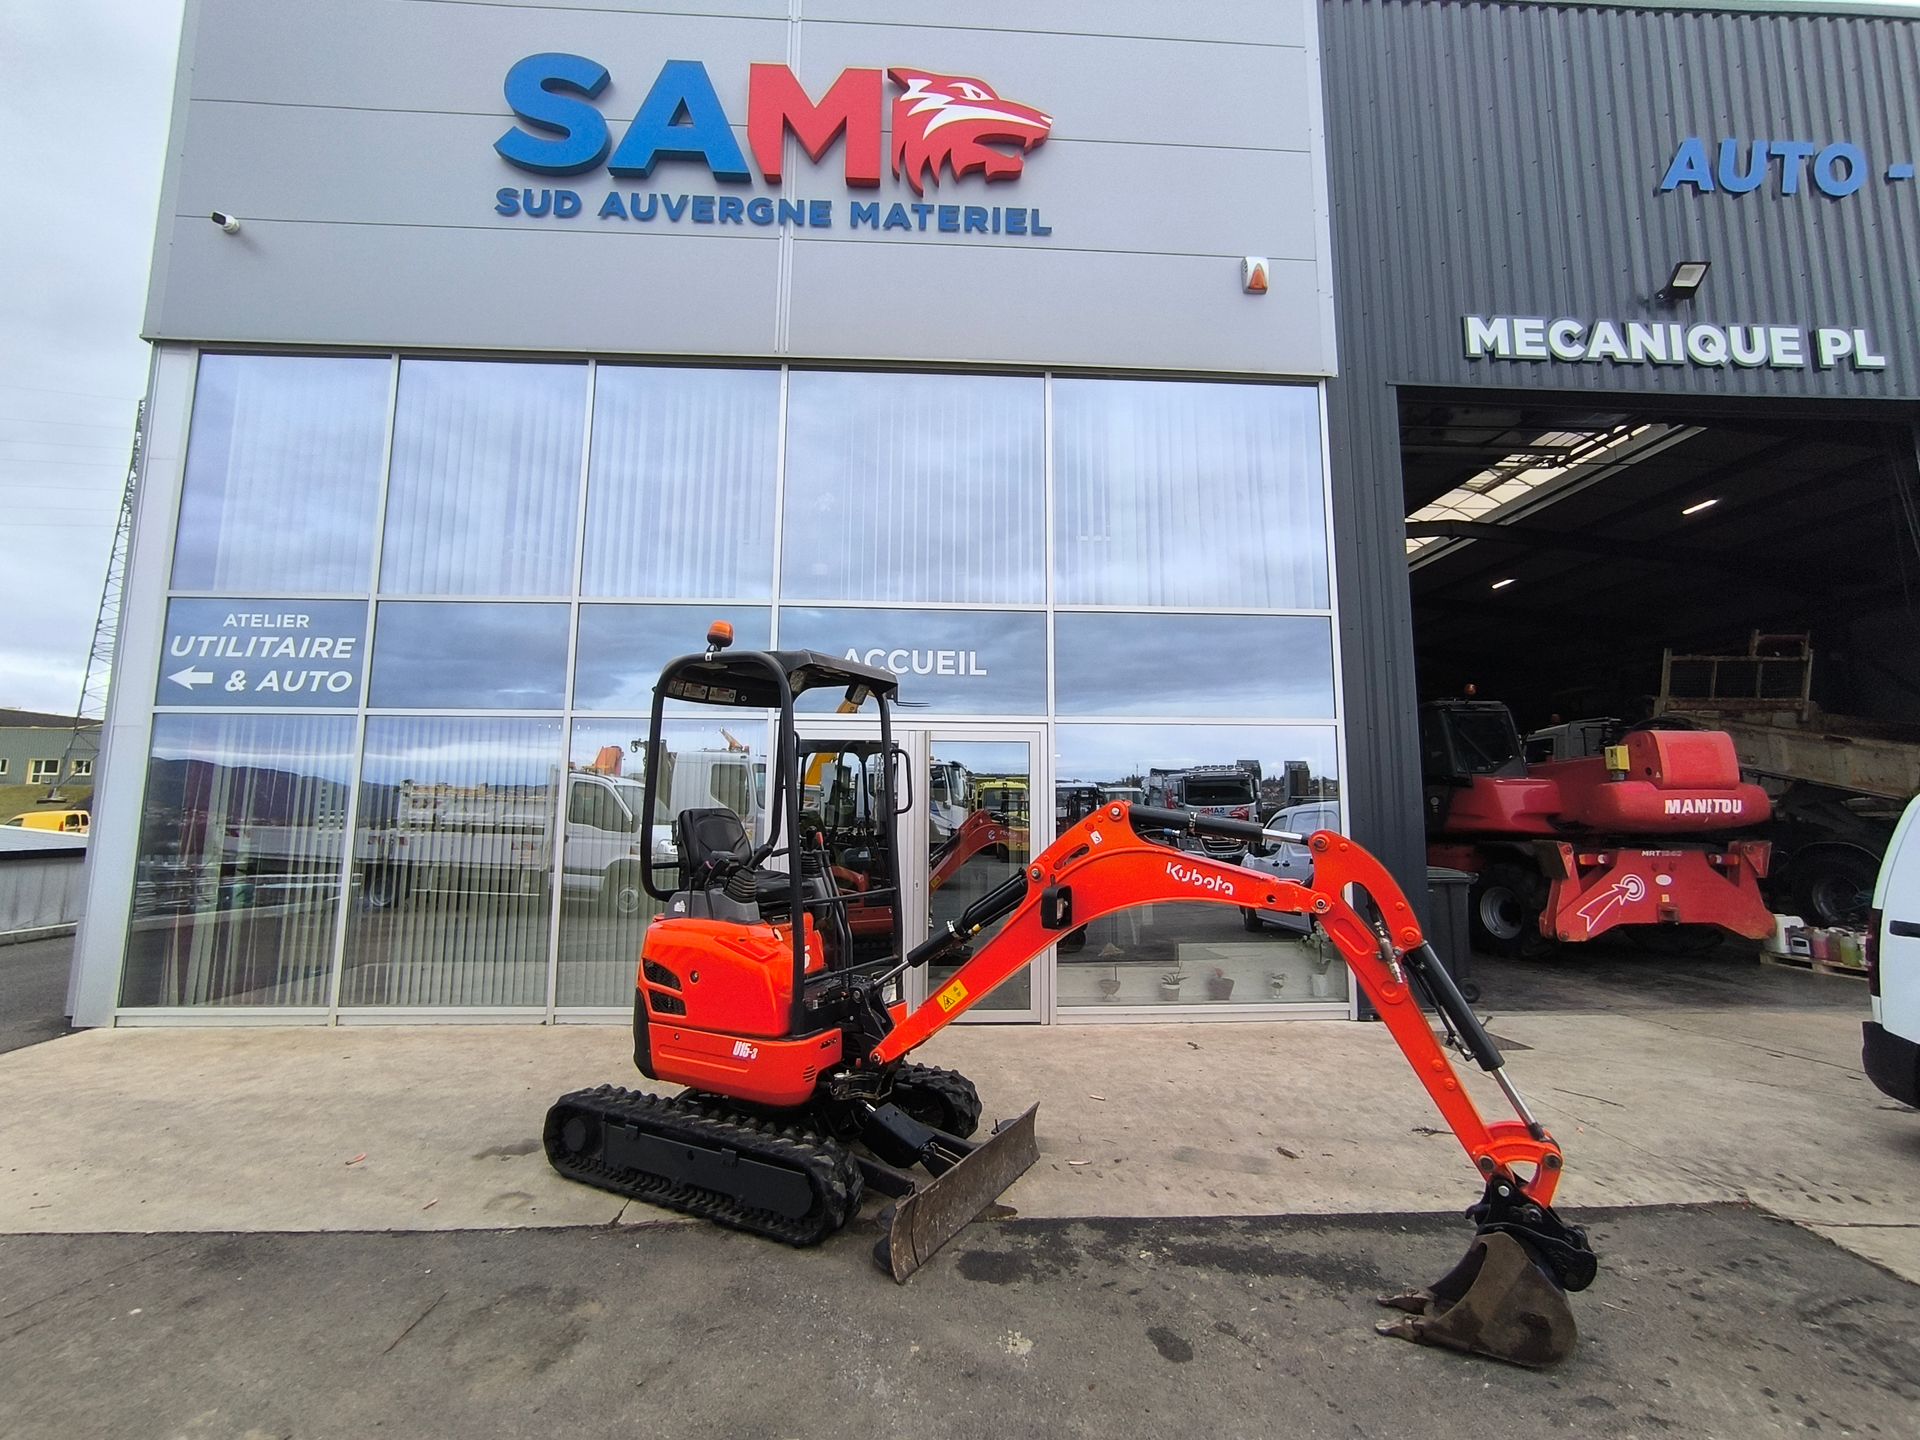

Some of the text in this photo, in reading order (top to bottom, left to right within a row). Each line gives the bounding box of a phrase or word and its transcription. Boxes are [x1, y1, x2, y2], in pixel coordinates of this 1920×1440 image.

[493, 52, 883, 187] SAM
[1659, 137, 1868, 196] AUTO
[494, 188, 1053, 236] SUD AUVERGNE MATERIEL
[1463, 314, 1888, 370] MECANIQUE PL
[223, 613, 310, 629] ATELIER
[170, 635, 356, 659] UTILITAIRE
[844, 648, 988, 676] ACCUEIL
[224, 670, 353, 693] & AUTO
[1664, 799, 1743, 815] MANITOU
[1165, 861, 1235, 896] Kubota
[732, 1040, 759, 1060] U15-3
